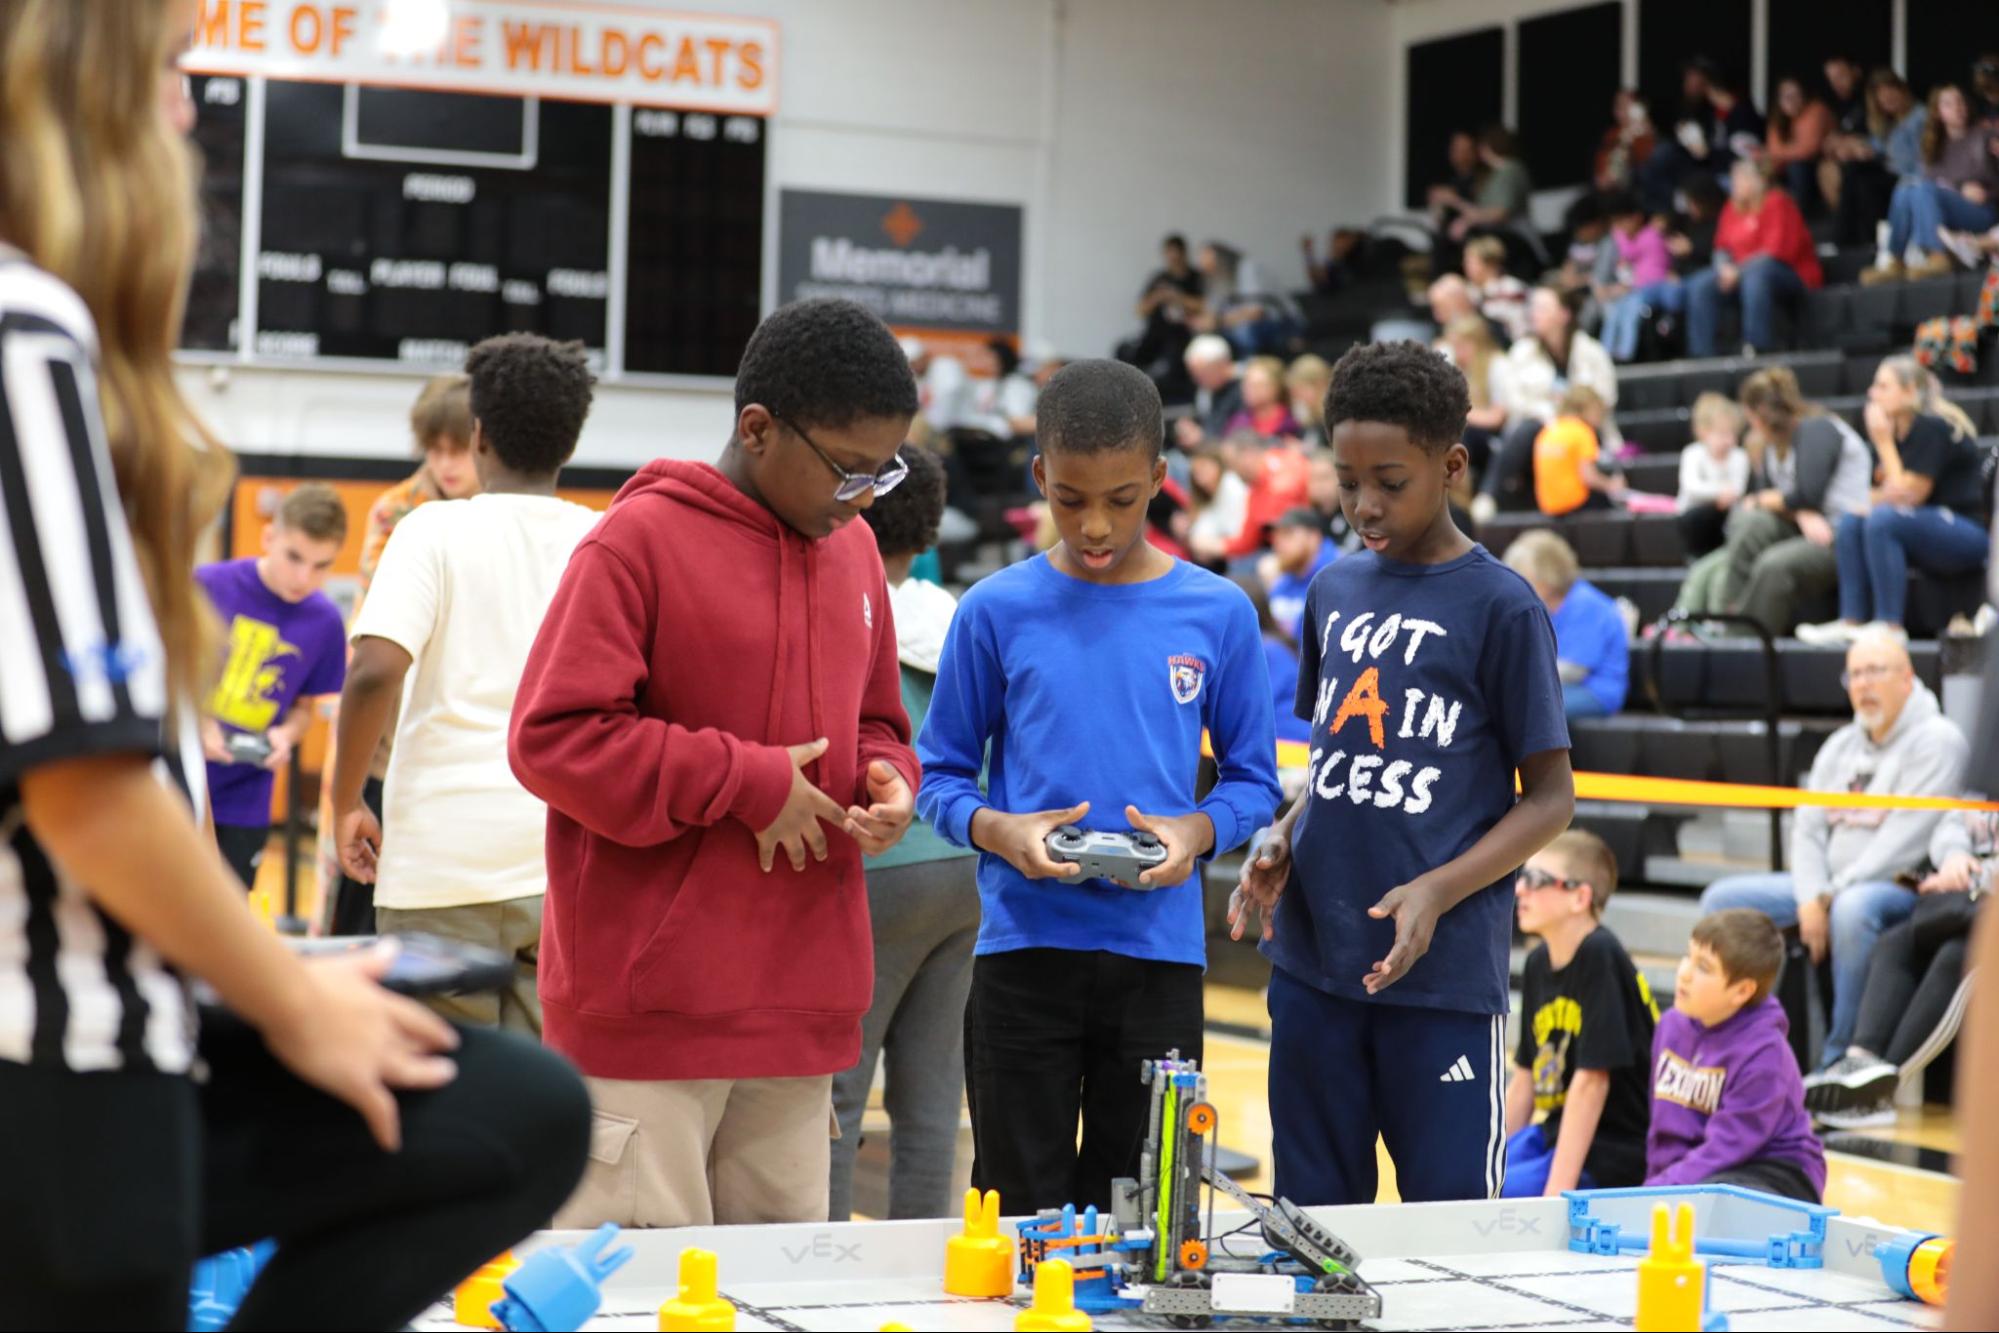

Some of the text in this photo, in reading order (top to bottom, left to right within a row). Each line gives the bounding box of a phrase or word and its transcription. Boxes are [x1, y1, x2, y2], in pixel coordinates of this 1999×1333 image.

[193, 0, 267, 52] ME
[290, 5, 358, 57] OF
[501, 17, 765, 91] WILDCATS
[811, 236, 990, 291] Memorial
[1321, 610, 1447, 665] I GOT
[1329, 666, 1390, 750] A
[1398, 687, 1462, 748] IN
[1845, 1233, 1878, 1258] VE
